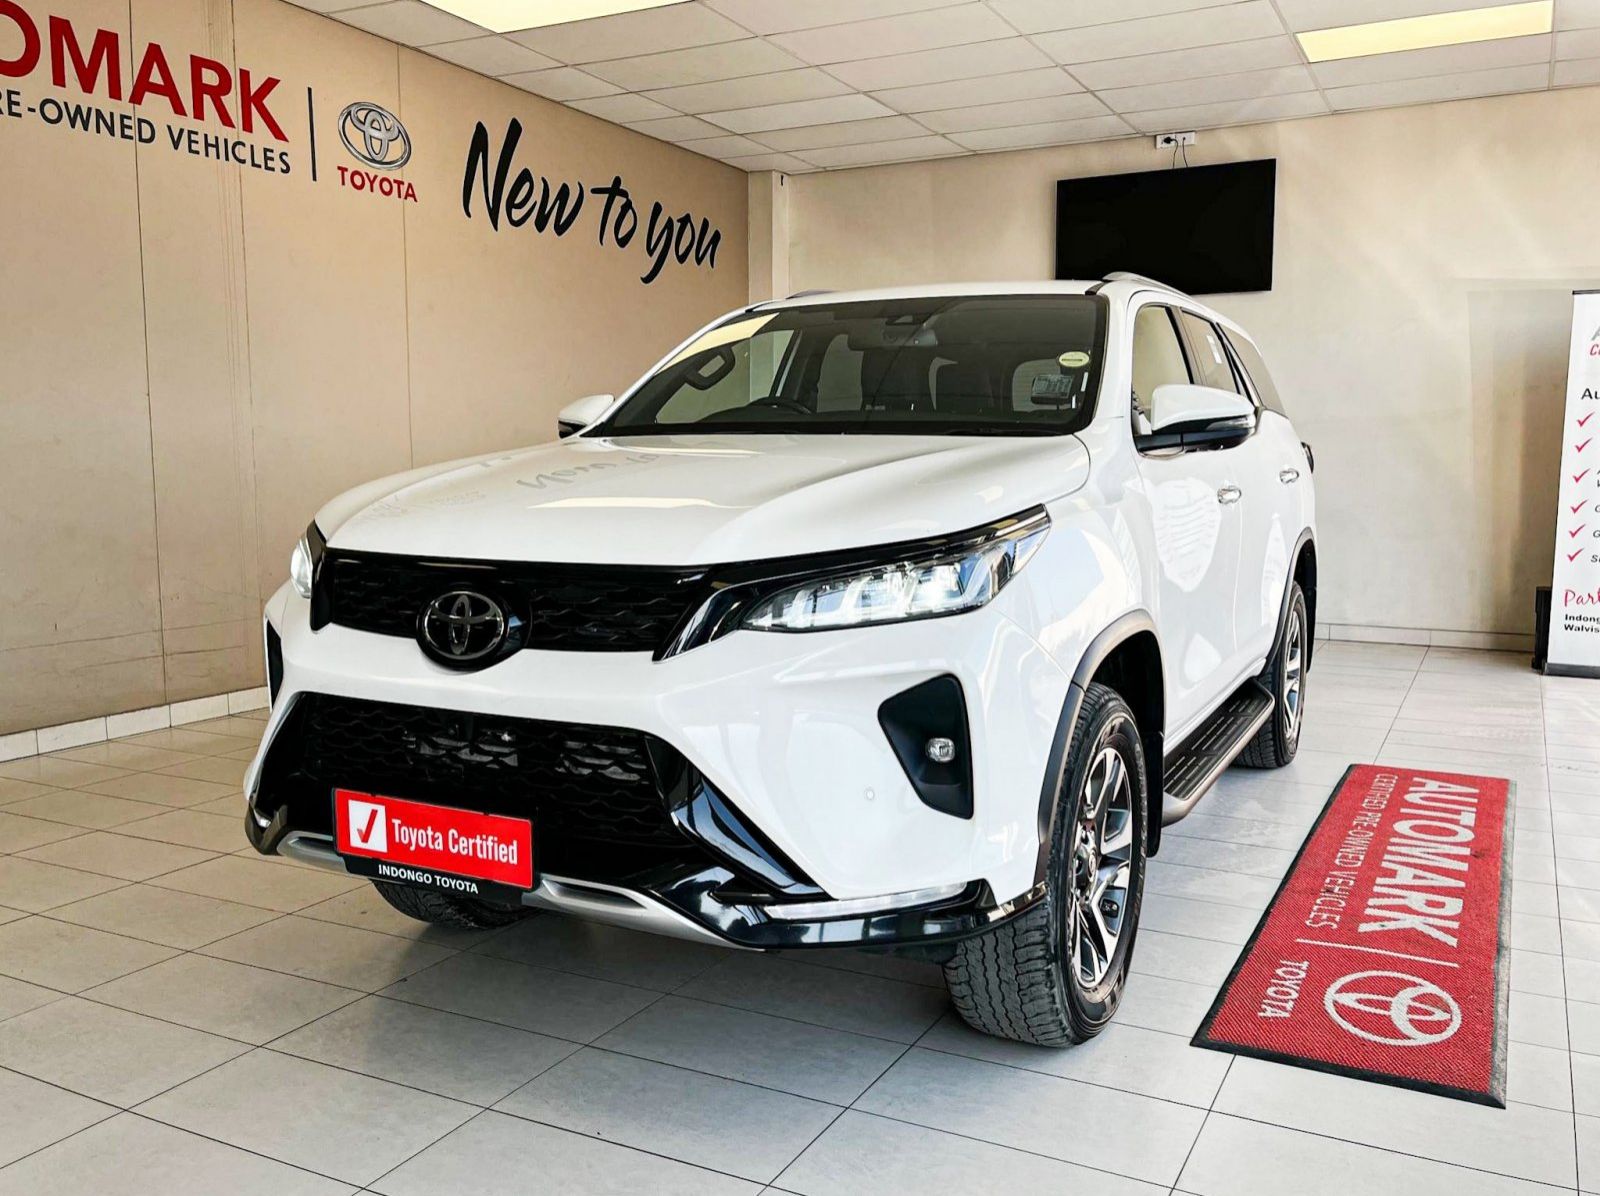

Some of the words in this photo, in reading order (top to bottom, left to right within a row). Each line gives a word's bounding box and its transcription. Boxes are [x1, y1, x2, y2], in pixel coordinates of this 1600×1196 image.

[0, 0, 289, 142] OMARK
[167, 124, 290, 174] VEHICLES
[337, 165, 418, 203] TOYOTA
[462, 117, 584, 237] New
[590, 175, 638, 249] to
[640, 201, 722, 284] you
[391, 818, 444, 851] Toyota
[448, 828, 518, 865] Certified
[1335, 810, 1382, 867] PRE-OWNED
[1357, 776, 1480, 948] AUTOMARK
[378, 863, 432, 884] INDONGO
[434, 875, 479, 894] TOYOTA
[1304, 871, 1359, 930] VEHICLES
[1258, 959, 1311, 1021] TOYOTA
